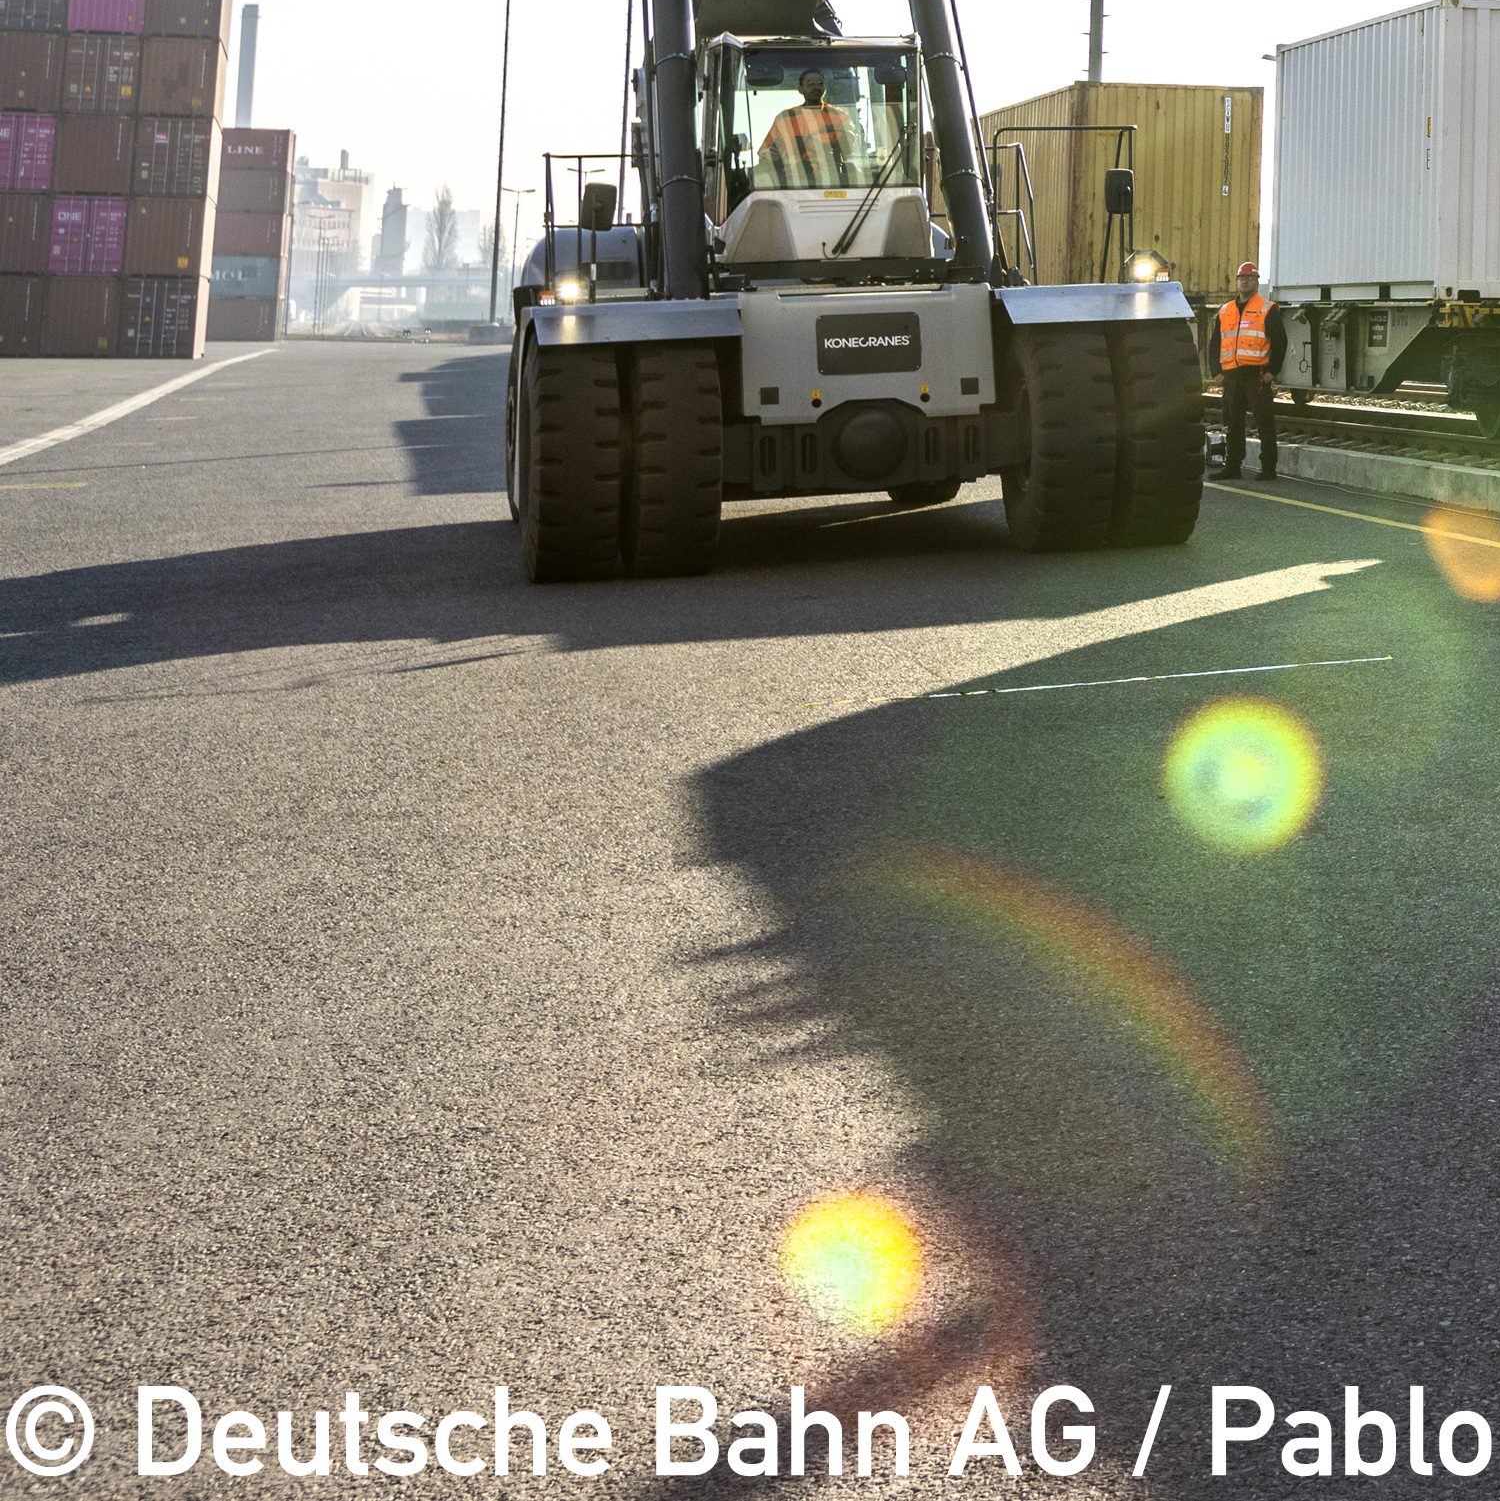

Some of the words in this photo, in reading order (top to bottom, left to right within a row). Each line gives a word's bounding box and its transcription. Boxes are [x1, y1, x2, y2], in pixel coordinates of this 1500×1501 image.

[227, 145, 265, 155] LINE
[57, 211, 82, 221] ONE
[824, 336, 910, 349] KONECRANES
